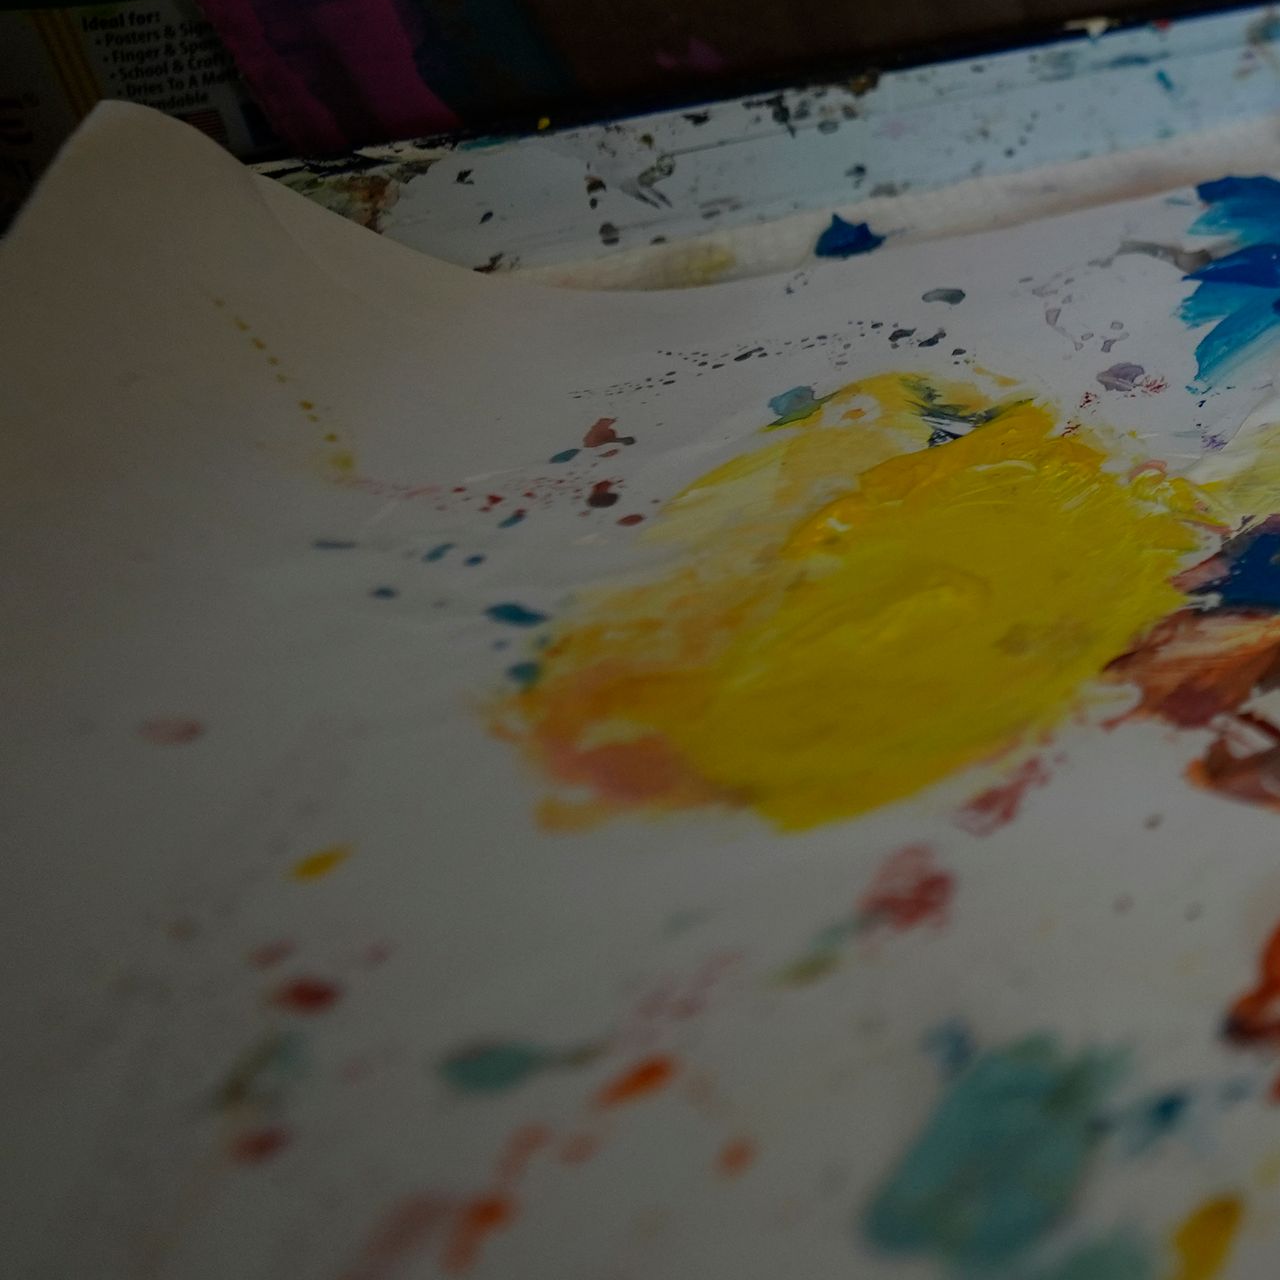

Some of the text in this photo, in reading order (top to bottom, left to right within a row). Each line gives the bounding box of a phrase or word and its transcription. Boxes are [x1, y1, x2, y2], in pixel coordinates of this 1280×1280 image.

[82, 11, 160, 31] Ideal for:
[105, 30, 160, 47] Posters
[164, 25, 176, 39] &
[112, 48, 159, 65] Finger
[164, 43, 175, 57] &
[119, 62, 168, 81] School
[172, 60, 184, 73] &
[126, 82, 164, 98] Dries
[168, 78, 184, 91] To
[189, 75, 197, 89] A
